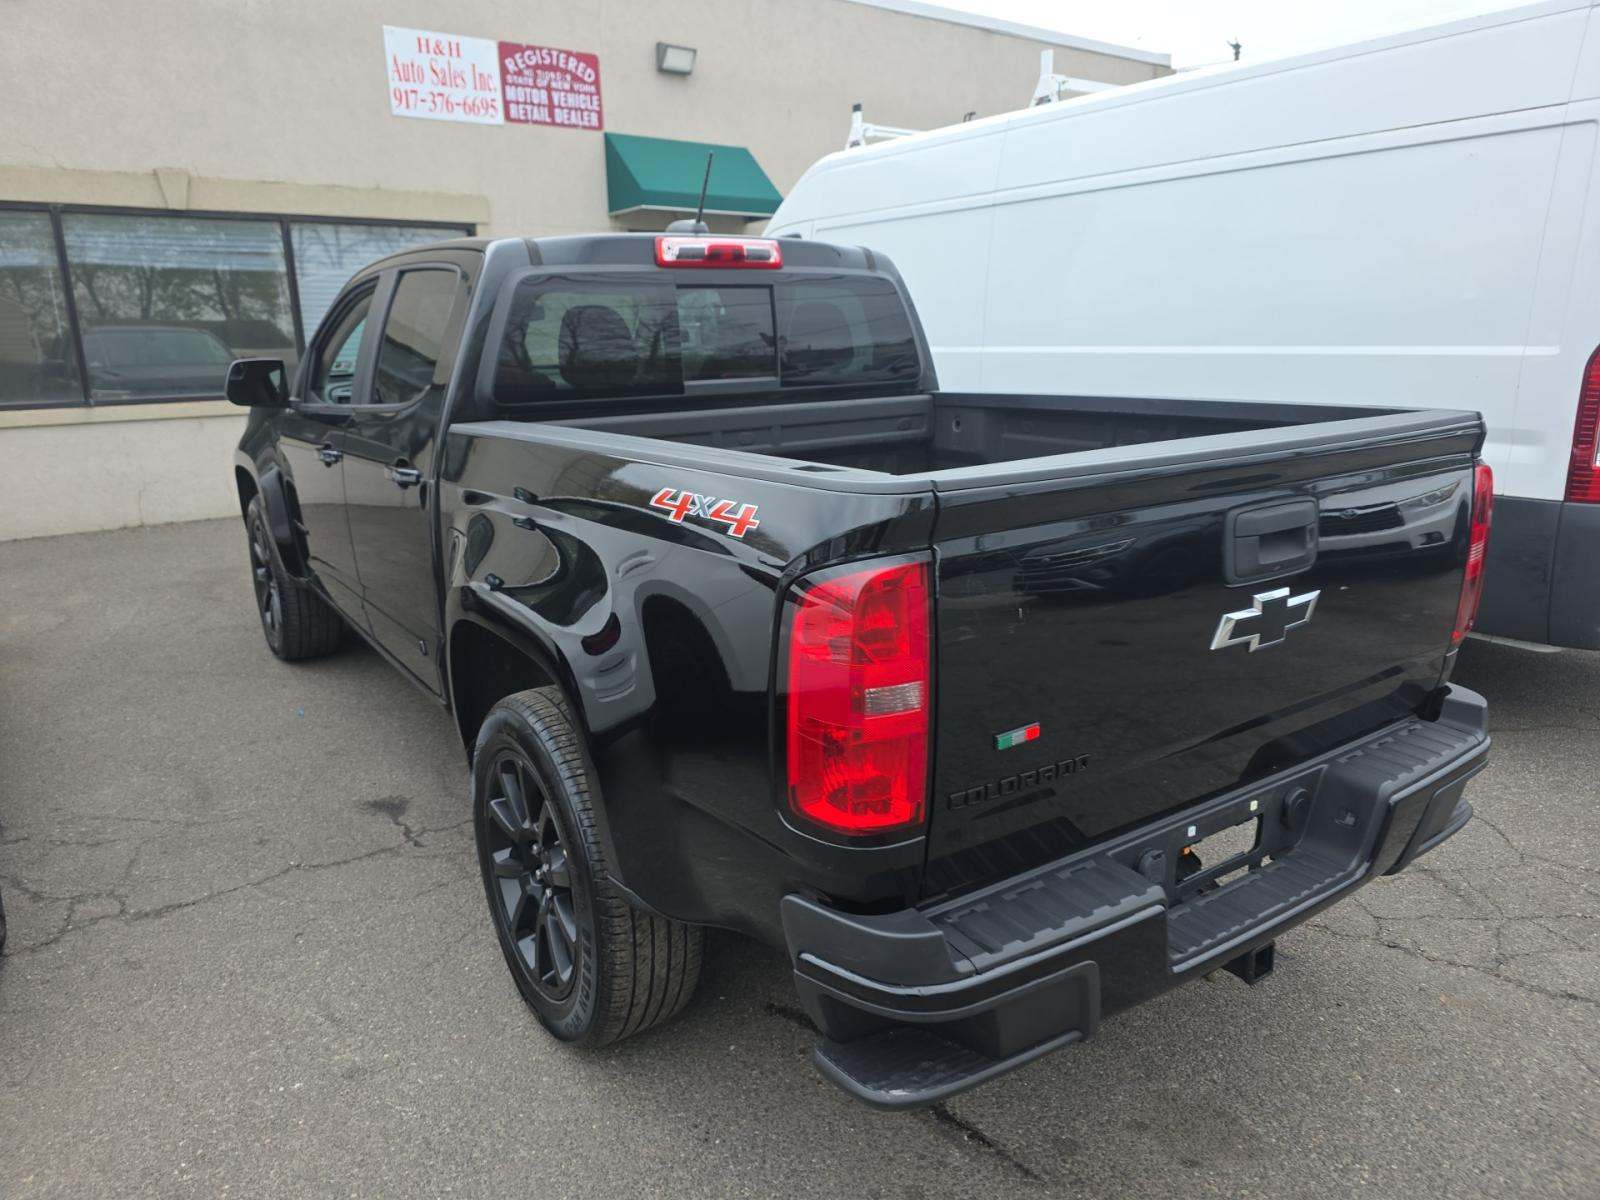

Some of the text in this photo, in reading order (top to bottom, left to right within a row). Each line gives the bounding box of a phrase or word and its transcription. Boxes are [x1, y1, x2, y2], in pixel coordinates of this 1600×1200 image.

[416, 36, 462, 58] H&H
[392, 54, 425, 85] Auto
[429, 58, 468, 90] Sales
[504, 48, 596, 83] REGISTERED
[393, 87, 499, 119] 917-376-6695
[505, 84, 601, 111] MOTOR VEHICLE
[509, 102, 600, 128] RETAIL DEALER
[947, 753, 1093, 811] COLORADO
